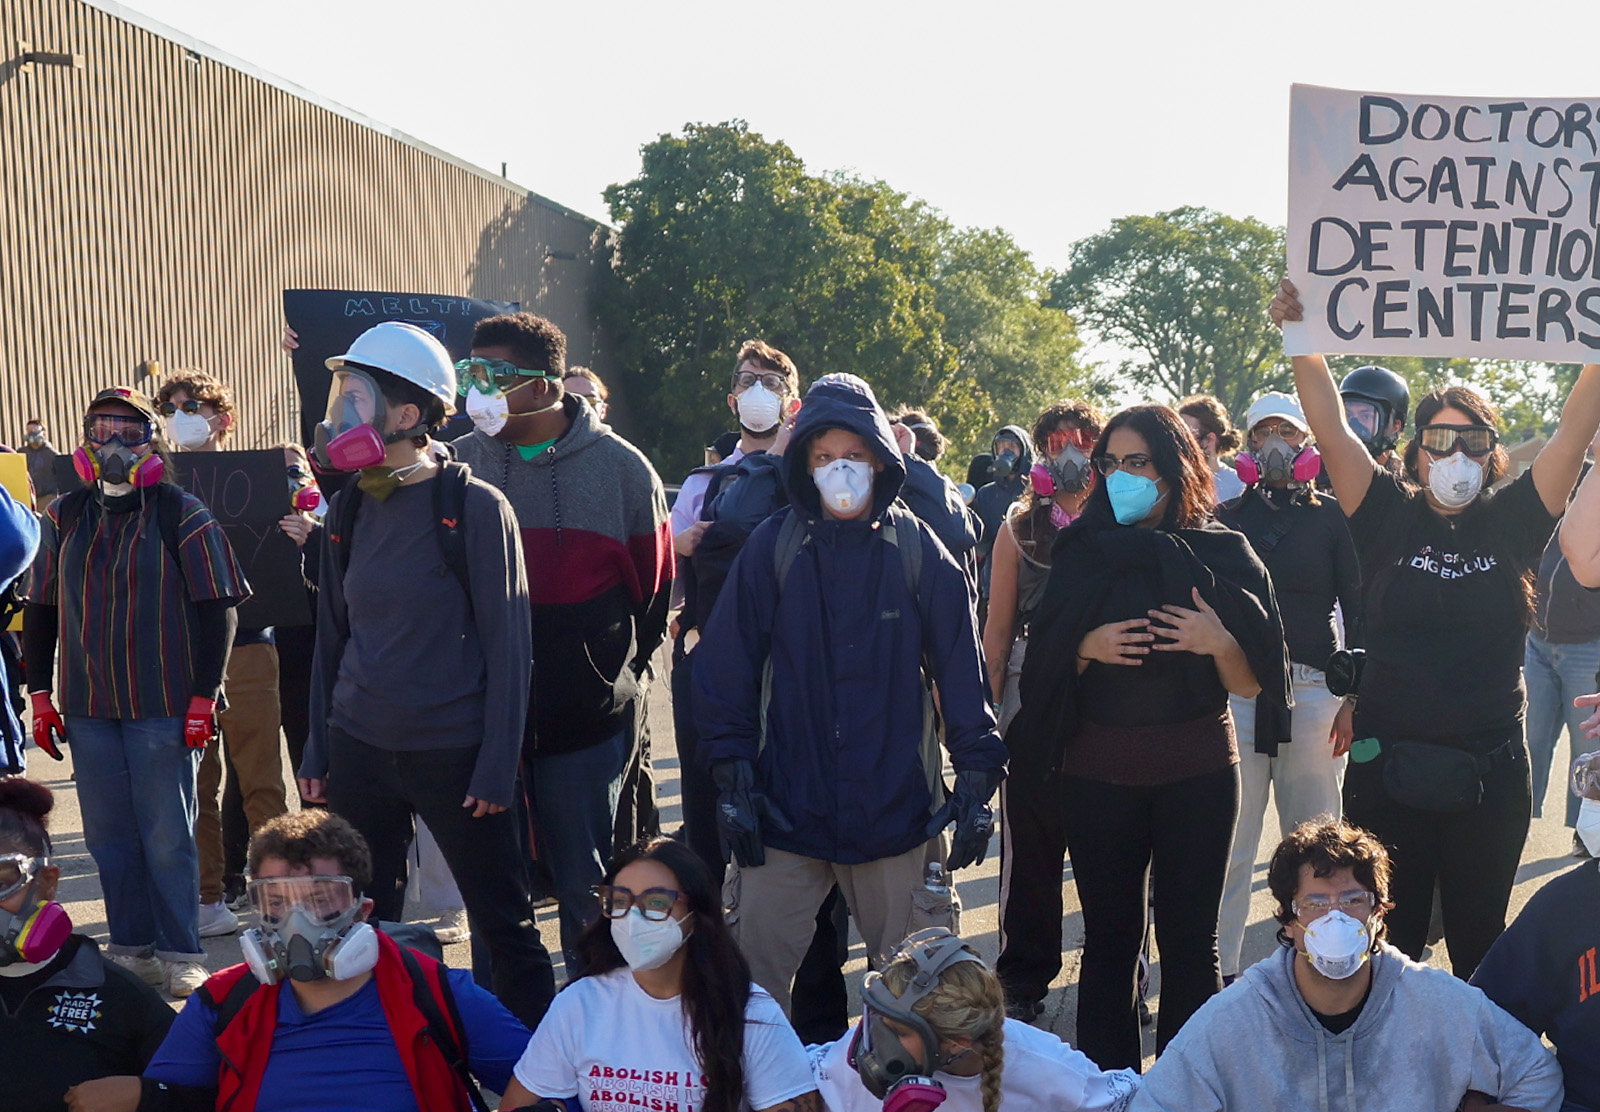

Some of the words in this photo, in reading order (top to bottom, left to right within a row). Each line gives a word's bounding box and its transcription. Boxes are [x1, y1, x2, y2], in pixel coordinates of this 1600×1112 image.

[345, 297, 472, 316] MELT!
[60, 1006, 89, 1020] FREE
[63, 1000, 91, 1009] MADE
[589, 1065, 678, 1086] ABOLISH
[589, 1078, 678, 1101] ABOLISH
